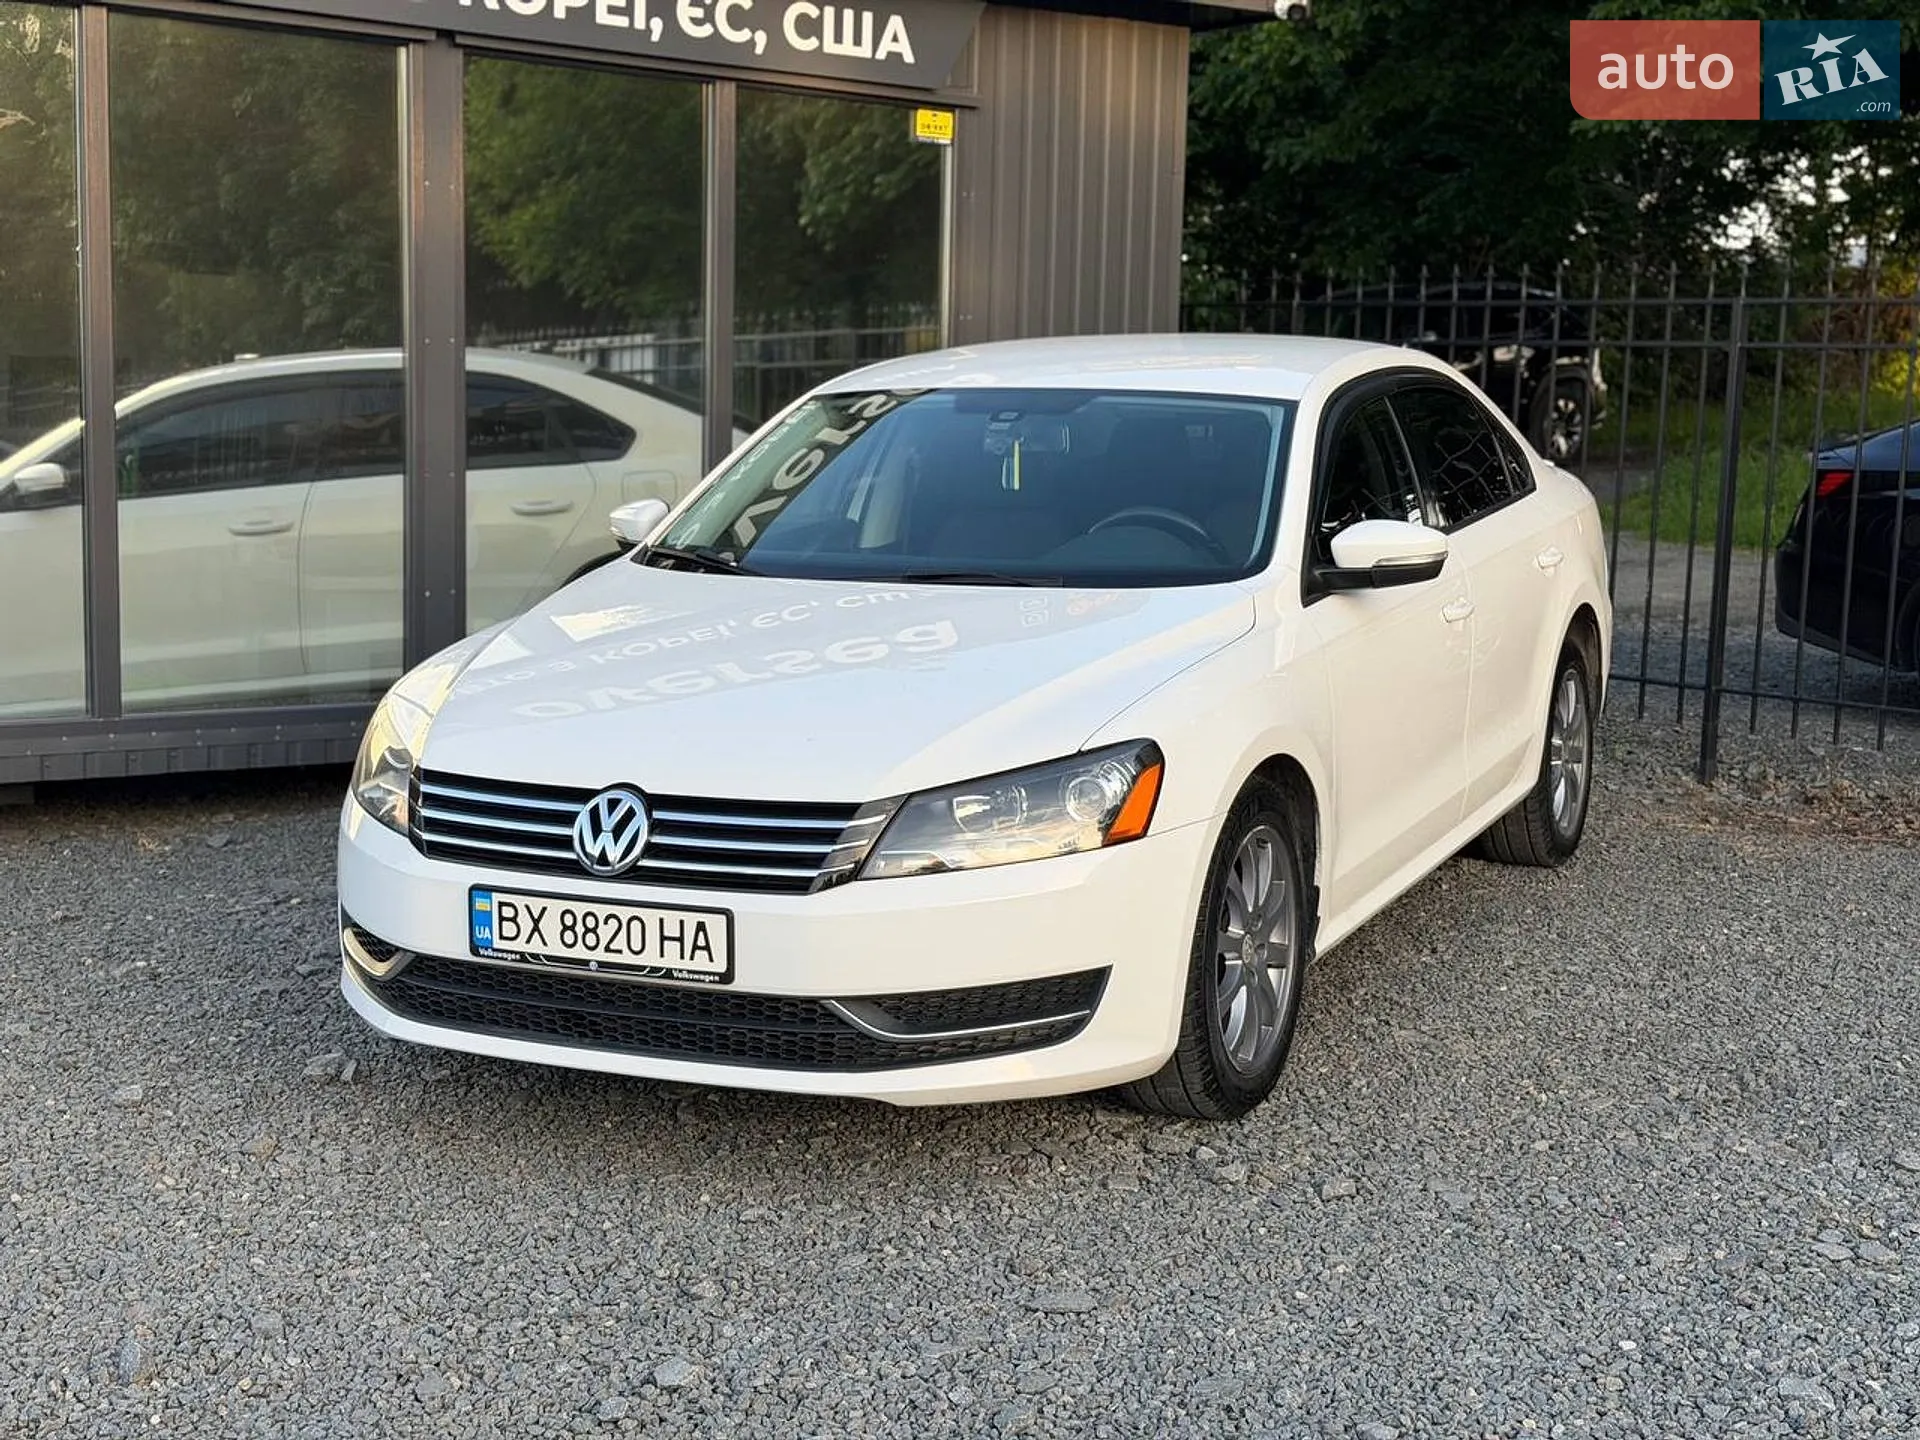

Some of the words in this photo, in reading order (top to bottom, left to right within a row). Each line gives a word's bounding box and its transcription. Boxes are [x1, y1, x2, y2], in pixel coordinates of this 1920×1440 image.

[676, 0, 767, 55] ЄС,
[783, 2, 915, 64] США
[475, 926, 492, 941] UA
[498, 901, 548, 947] BX
[559, 908, 646, 955] 8820
[659, 917, 714, 963] HA
[478, 946, 521, 961] Volkswagen
[672, 968, 720, 983] Volkswagen
